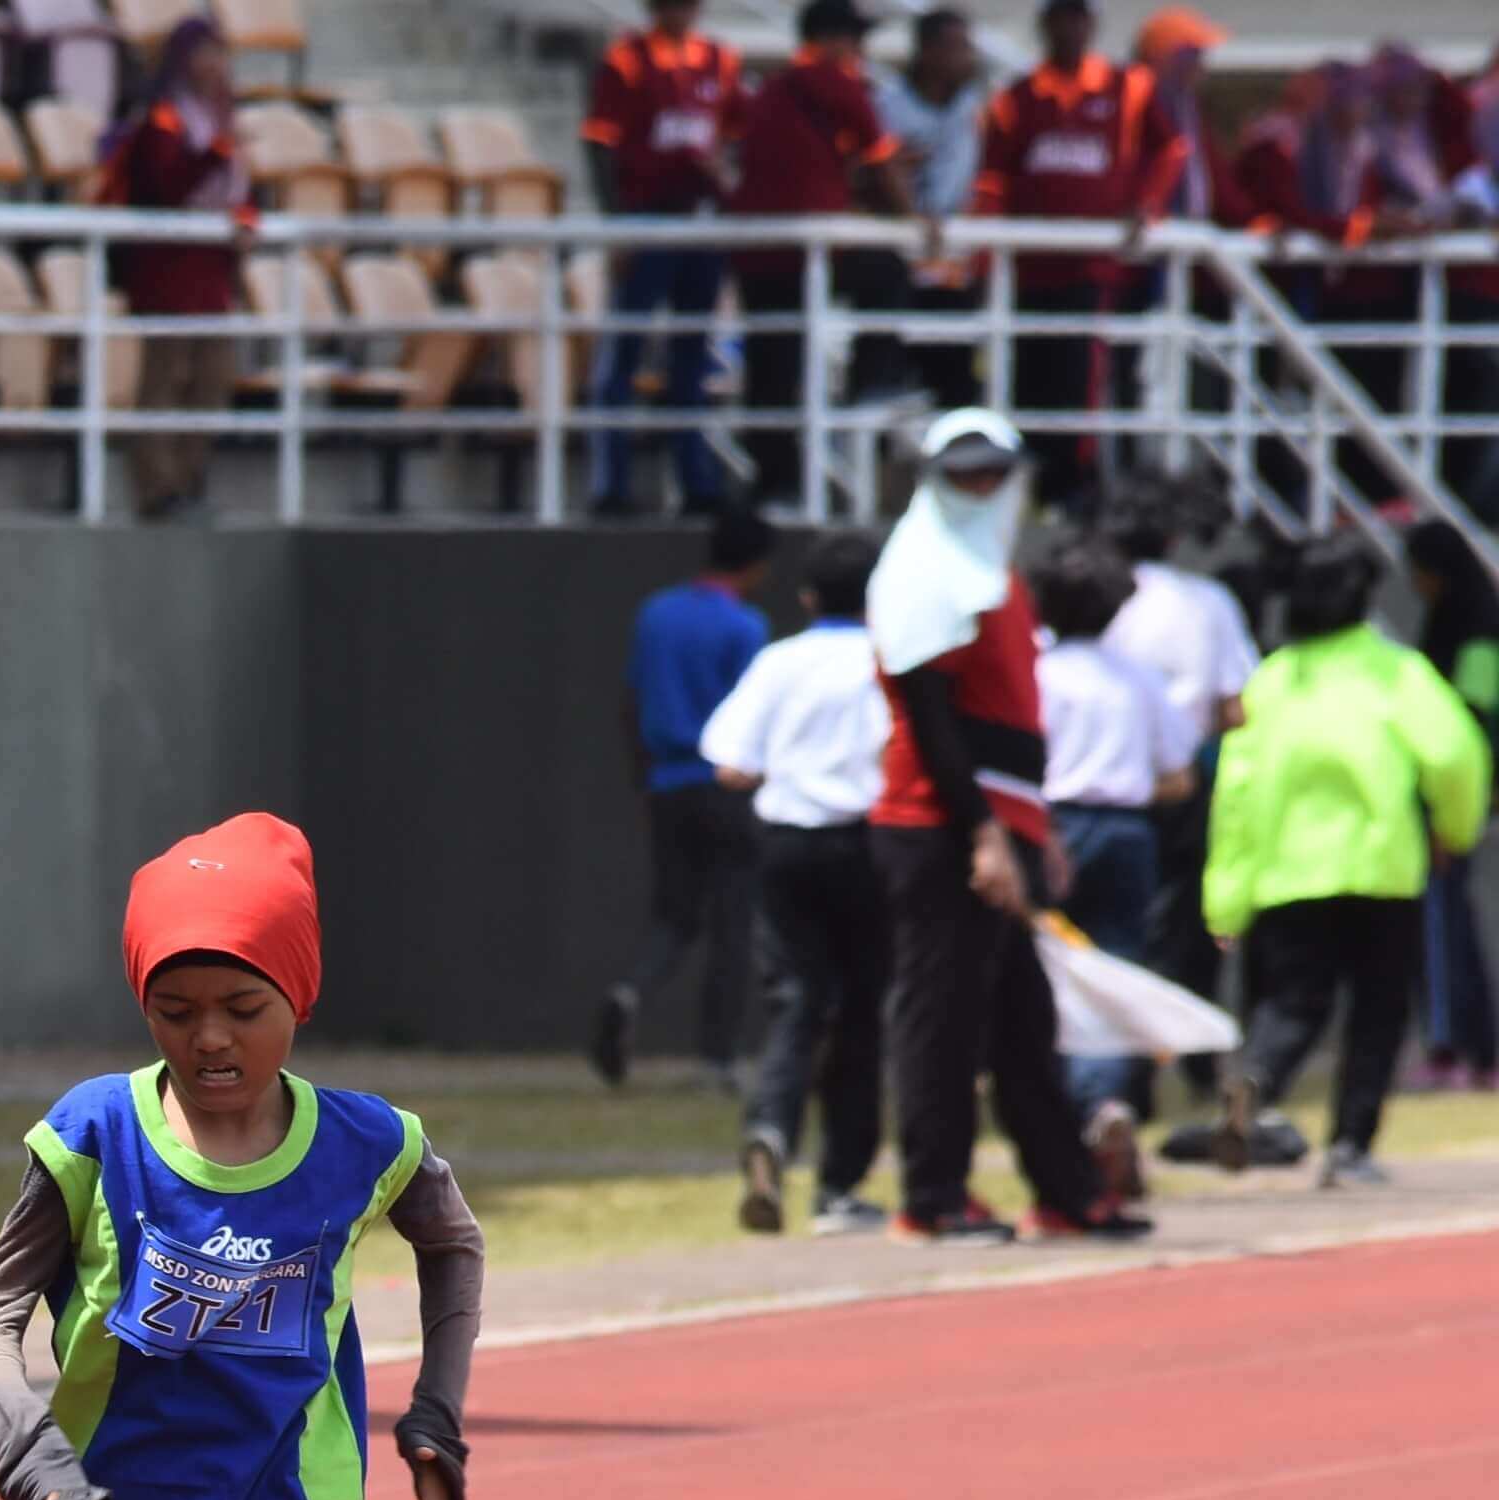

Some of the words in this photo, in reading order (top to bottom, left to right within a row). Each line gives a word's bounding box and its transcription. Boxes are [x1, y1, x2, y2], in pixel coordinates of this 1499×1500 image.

[144, 1247, 189, 1279] MSSD
[191, 1269, 233, 1292] ZON
[138, 1277, 278, 1341] ZT21
